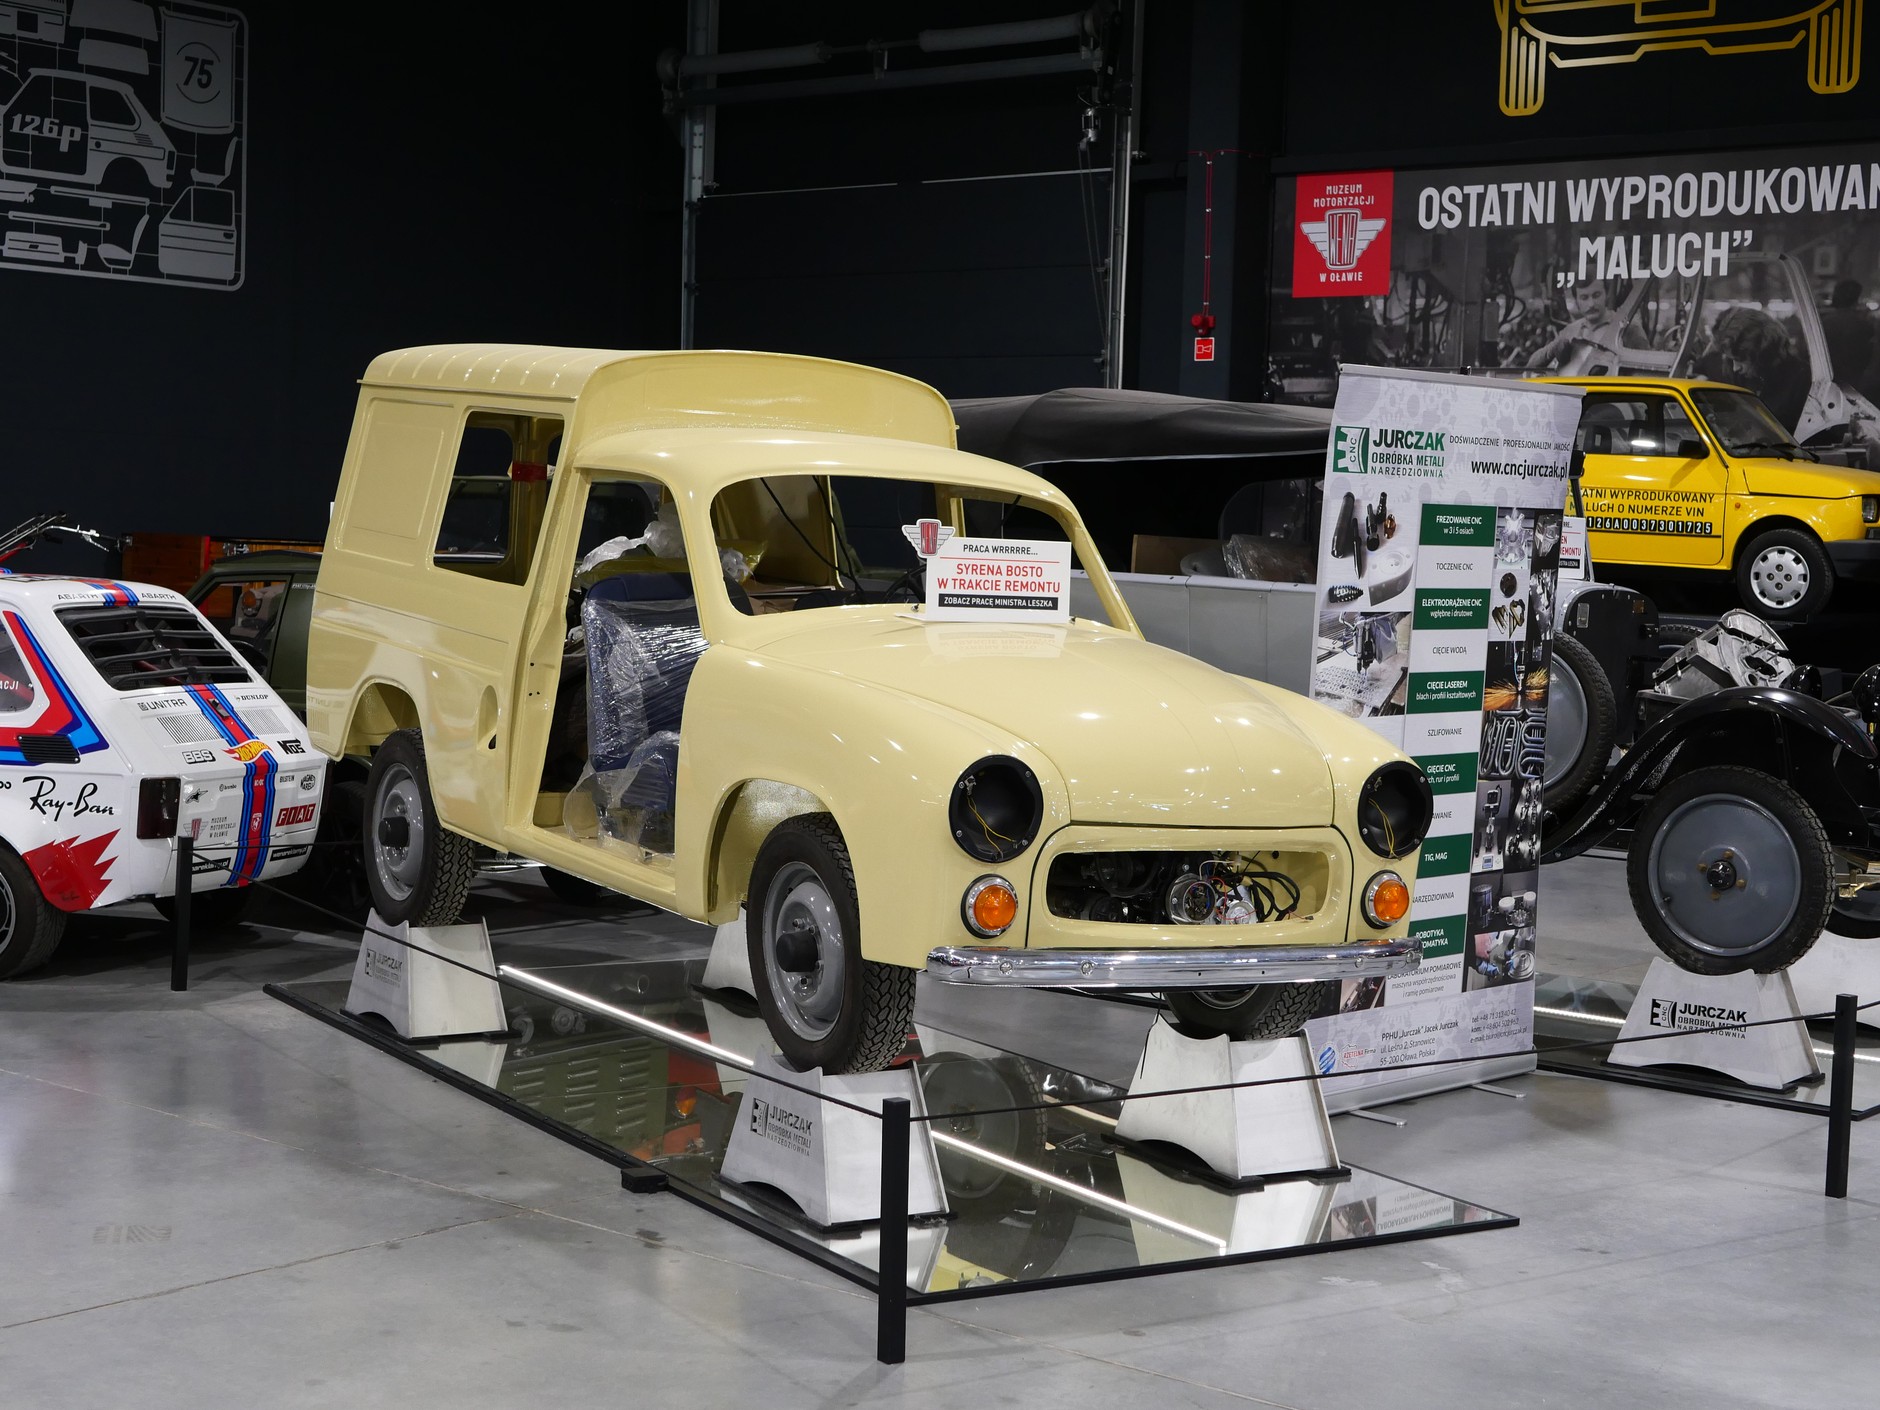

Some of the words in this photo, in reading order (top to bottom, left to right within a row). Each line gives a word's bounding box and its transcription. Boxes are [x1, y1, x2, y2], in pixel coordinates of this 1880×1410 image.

[183, 56, 214, 89] 75
[1326, 184, 1362, 195] MUZEUM
[1313, 196, 1374, 207] MOTORYZACJI
[1418, 180, 1556, 230] OSTATNI
[1556, 230, 1754, 288] „MALUCH”
[1320, 273, 1327, 282] W
[1330, 272, 1363, 282] OŁAWIE
[1373, 428, 1446, 452] JURCZAK
[1450, 434, 1500, 447] DOŚWIADCZENIE
[1503, 440, 1552, 450] PROFESJONALIZM
[1553, 442, 1570, 452] JAKOŚĆ
[1372, 450, 1413, 465] OBRÓBKA
[1416, 455, 1444, 467] METALI
[1371, 466, 1444, 478] NARZĘDZIOWNIA
[1471, 459, 1568, 481] www.cncjurczak.pl
[1610, 490, 1714, 503] WYPRODUKOWANY
[1570, 502, 1614, 513] MLUCH
[1618, 504, 1624, 513] O
[1628, 505, 1682, 516] NUMERZE
[1686, 507, 1704, 517] VIN
[1436, 516, 1470, 524] FREZOWANIE
[963, 544, 990, 553] PRACA
[991, 545, 1038, 555] WRRRRRE...
[1560, 547, 1581, 556] EMONTU
[956, 564, 1003, 576] SYRENA
[1006, 566, 1043, 577] BOSTO
[937, 578, 949, 589] W
[952, 578, 1001, 591] TRAKCIE
[1005, 580, 1060, 593] REMONTU
[944, 597, 970, 605] ZOBACZ
[972, 598, 993, 607] PRACĘ
[1422, 597, 1470, 608] ELEKTRODRĄŻENIE
[1433, 646, 1449, 655] CIĘCIE
[1450, 647, 1467, 655] WODĄ
[1427, 681, 1444, 690] CIĘCIE
[1445, 680, 1468, 689] LASEREM
[149, 699, 187, 710] UNITRA
[1428, 728, 1462, 736] SZLIFOWANIE
[277, 739, 306, 754] NOS
[182, 750, 216, 764] BBS
[1427, 765, 1444, 774] GIĘCIE
[23, 776, 114, 822] Ray-Ban
[278, 806, 315, 825] FIAT
[1416, 929, 1444, 939] ROBOTYKA
[1422, 938, 1448, 948] OMATYKA
[1430, 962, 1462, 972] POMIAROWE
[1392, 981, 1411, 989] maszyna
[1679, 1003, 1747, 1023] JURCZAK
[1382, 1031, 1398, 1041] PPHU
[1424, 1025, 1438, 1034] Jacek
[1439, 1020, 1459, 1031] Jurczak
[1719, 1022, 1747, 1032] MALI
[1388, 1043, 1403, 1052] Leśna
[1410, 1037, 1435, 1048] Stanowice
[1380, 1056, 1400, 1066] 55-200
[1419, 1048, 1436, 1059] Polska
[770, 1106, 812, 1136] JURCZAK
[793, 1133, 812, 1149] METALI
